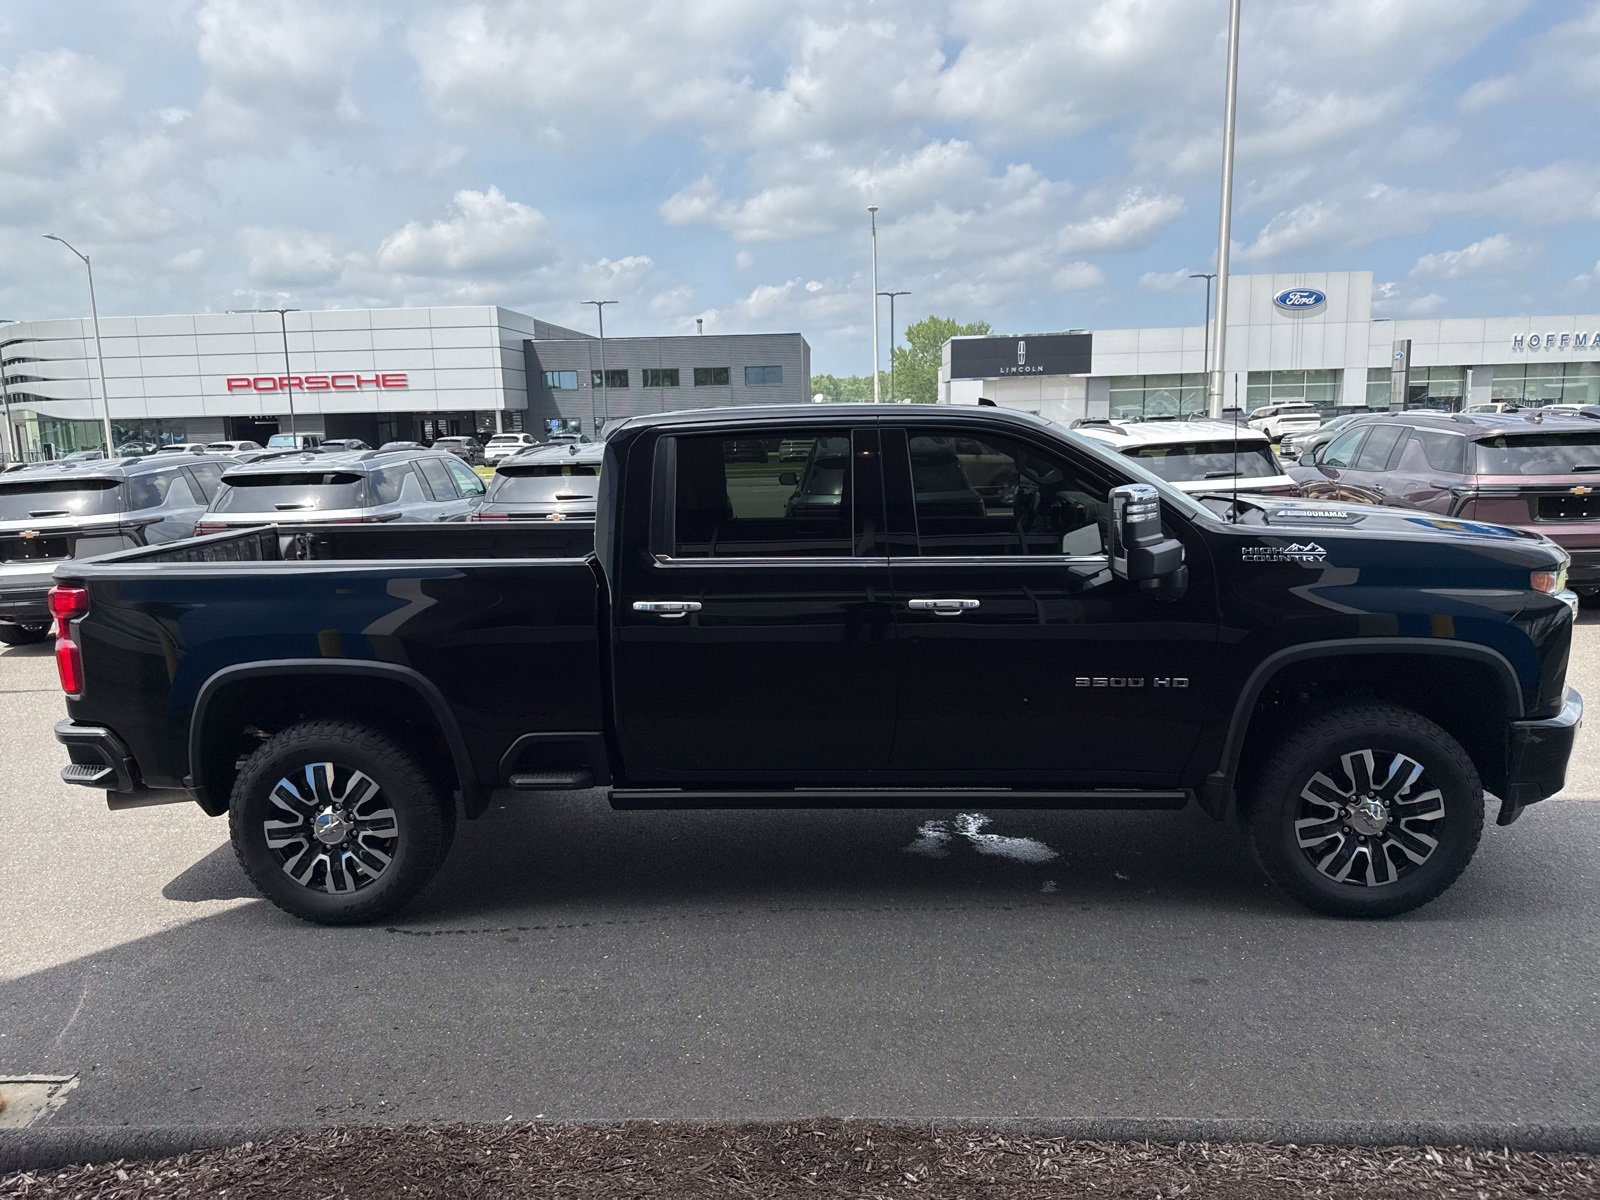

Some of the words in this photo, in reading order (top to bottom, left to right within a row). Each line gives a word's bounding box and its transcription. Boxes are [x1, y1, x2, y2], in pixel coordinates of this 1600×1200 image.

[1286, 292, 1316, 305] Ford
[1000, 366, 1044, 374] LINCOLN
[226, 373, 409, 392] PORSCHE
[1075, 677, 1144, 687] 3500
[1153, 677, 1189, 687] HD
